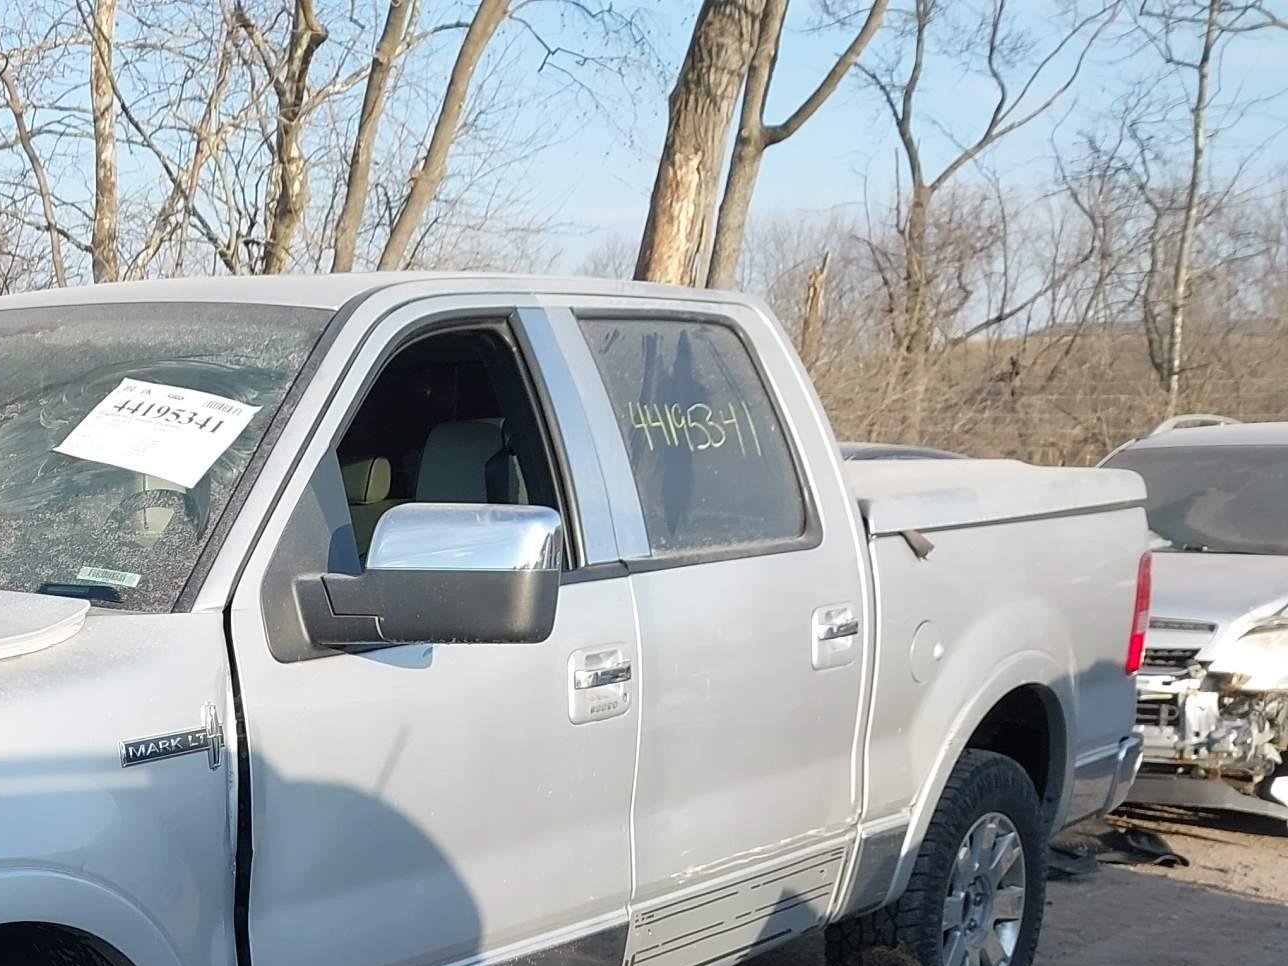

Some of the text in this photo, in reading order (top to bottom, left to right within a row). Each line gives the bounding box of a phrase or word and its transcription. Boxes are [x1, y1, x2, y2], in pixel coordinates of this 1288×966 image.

[112, 399, 225, 433] 44195341
[628, 400, 762, 457] 44195341
[128, 732, 207, 759] MARK LT
